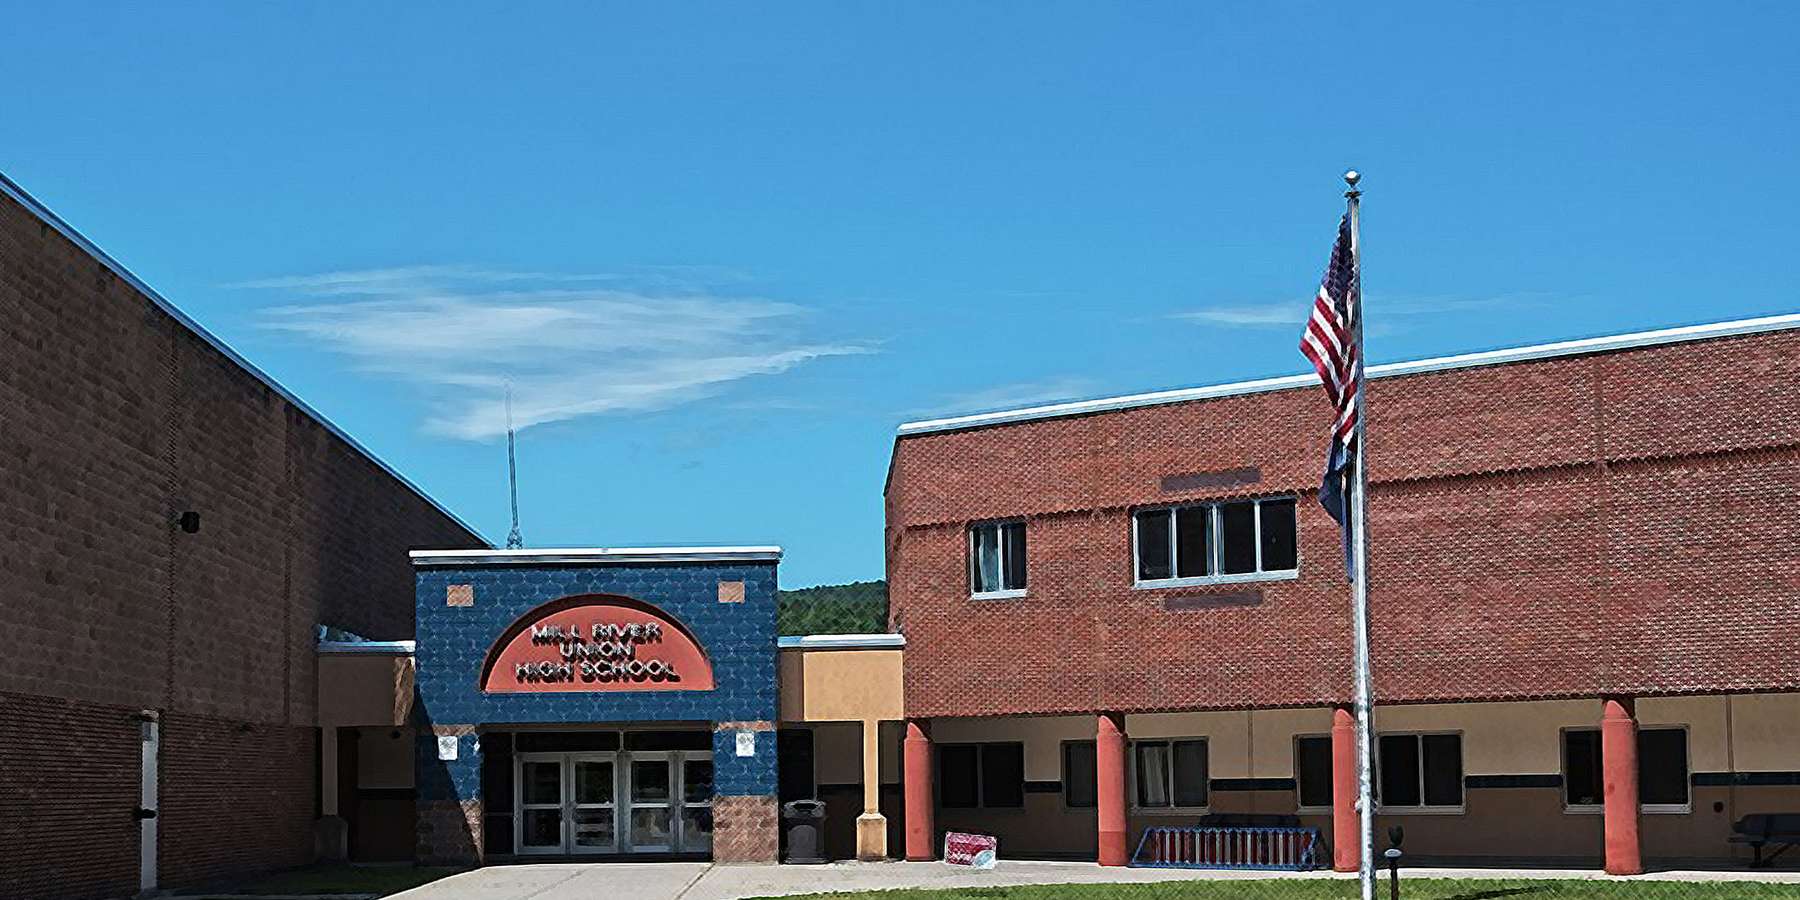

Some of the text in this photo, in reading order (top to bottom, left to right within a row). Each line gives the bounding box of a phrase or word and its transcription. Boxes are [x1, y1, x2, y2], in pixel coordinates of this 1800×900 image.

[531, 623, 662, 643] MILL RIVER
[559, 641, 635, 660] UNION
[516, 660, 680, 682] HIGH SCHOOL
